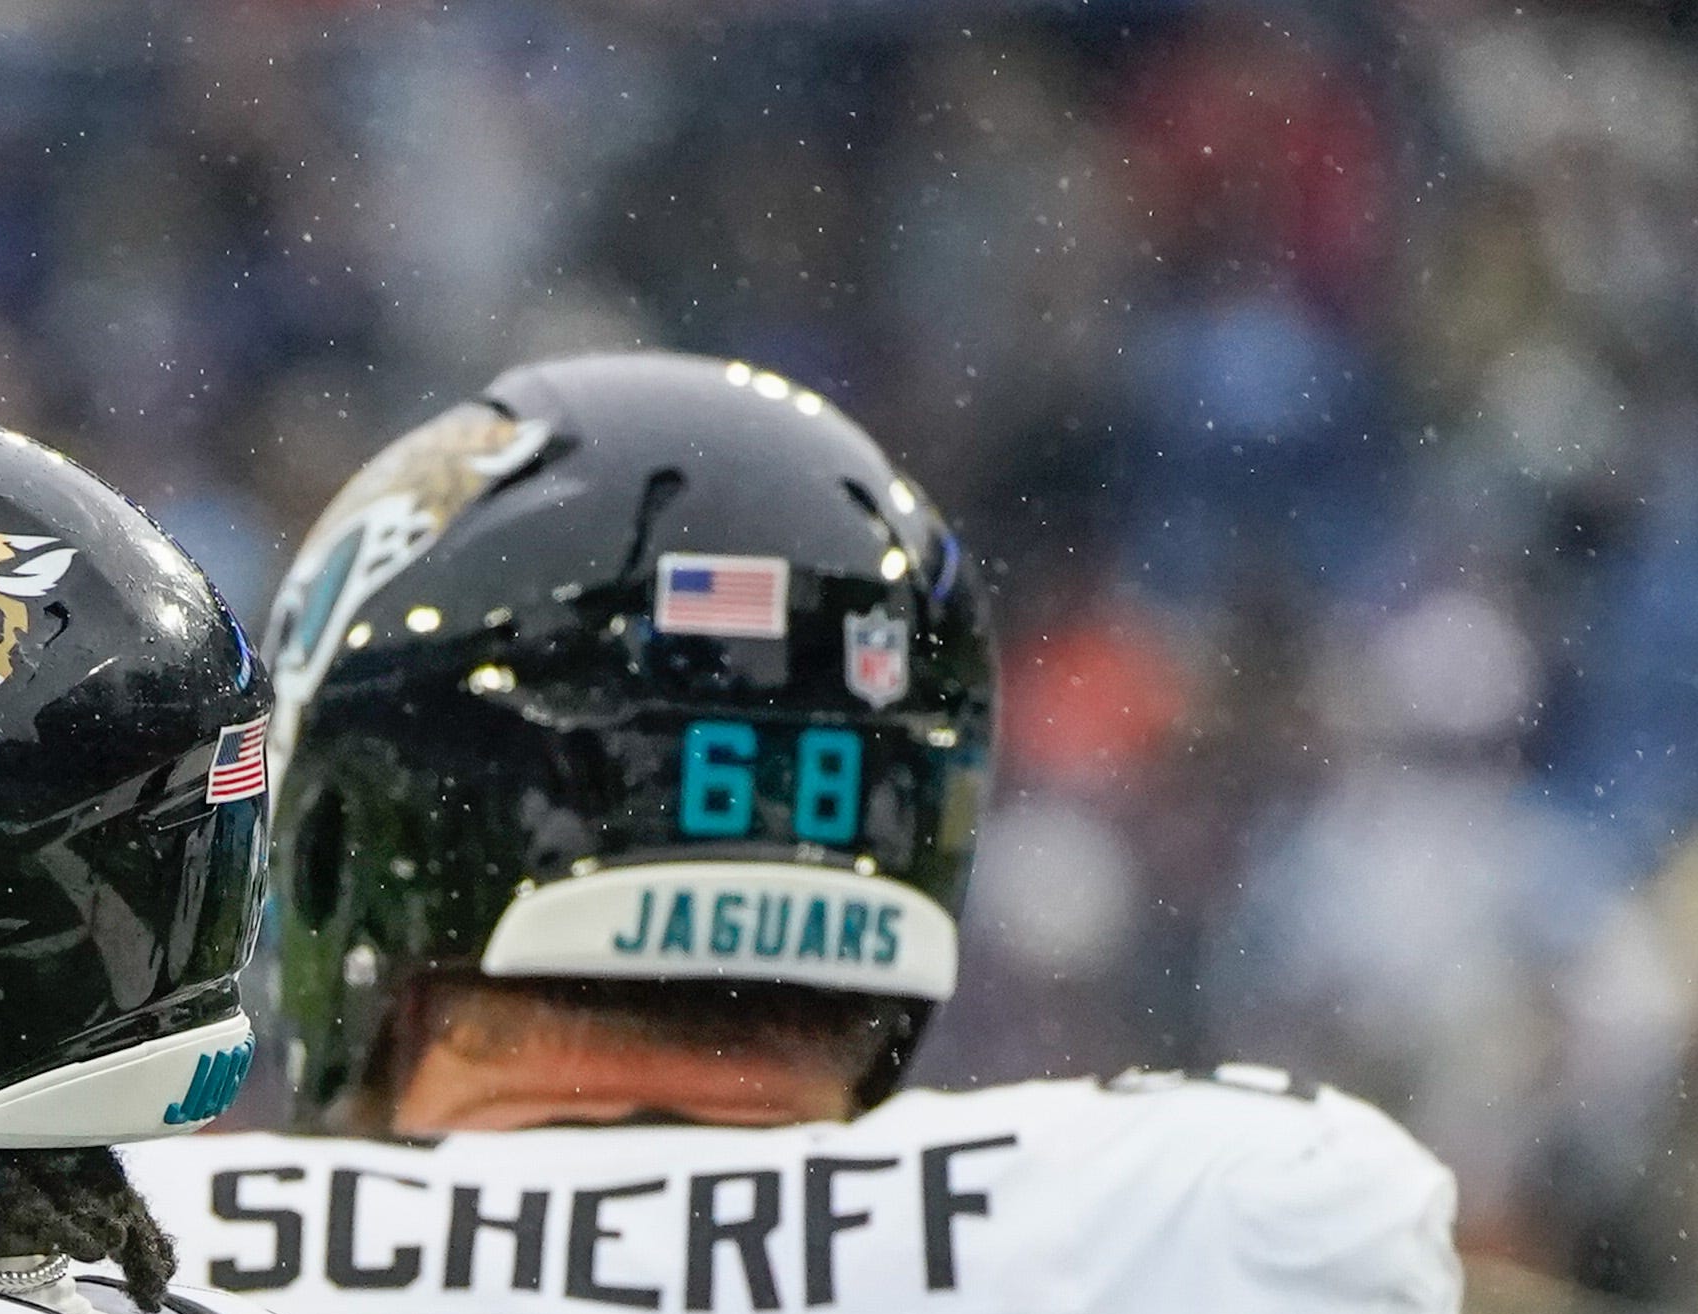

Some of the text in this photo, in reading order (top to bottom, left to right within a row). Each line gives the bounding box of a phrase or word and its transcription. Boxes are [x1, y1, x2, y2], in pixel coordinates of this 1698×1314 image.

[680, 719, 863, 846] 68
[613, 888, 901, 963] JAGUARS
[207, 1135, 1017, 1312] SCHERFF
